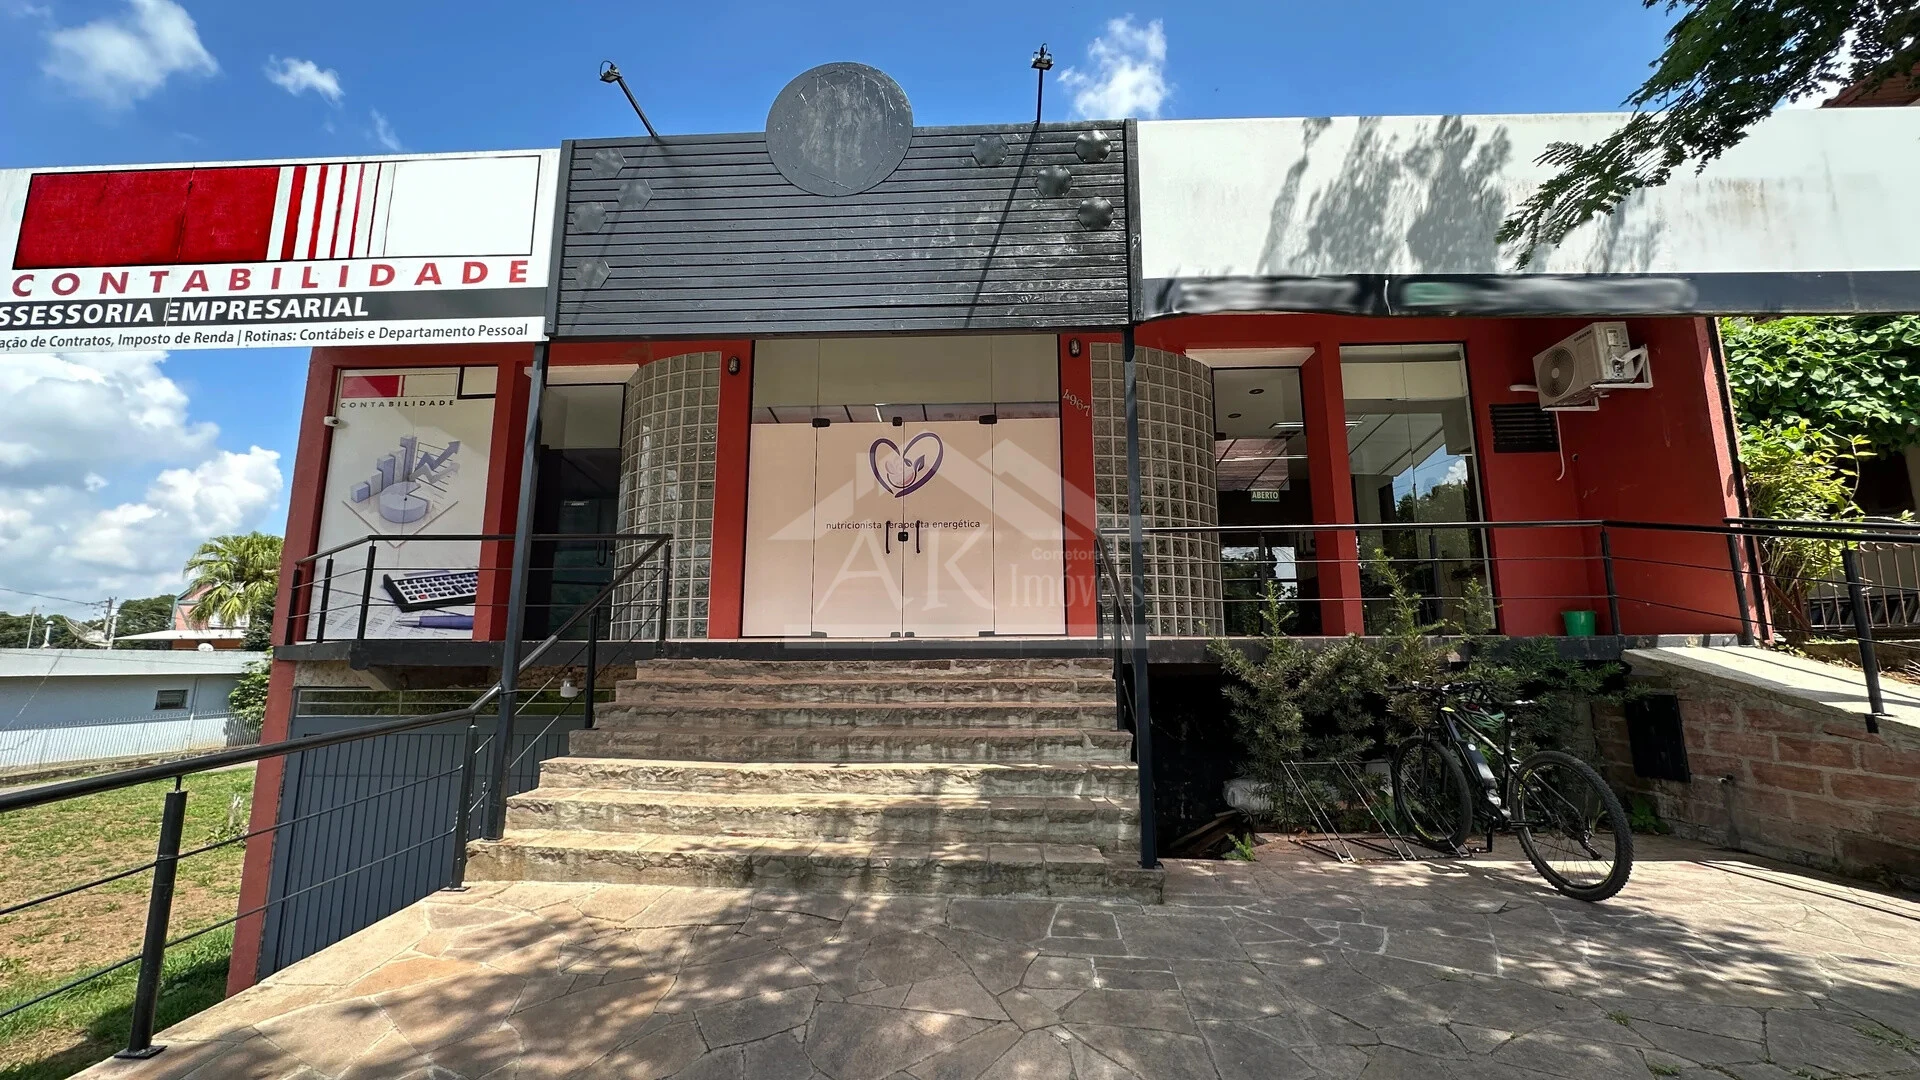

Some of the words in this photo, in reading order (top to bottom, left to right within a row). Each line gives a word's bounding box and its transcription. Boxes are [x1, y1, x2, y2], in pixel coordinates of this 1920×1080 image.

[12, 260, 530, 297] CONTABILIDADE
[165, 297, 369, 323] EMPRESARIAL
[30, 335, 46, 349] de
[49, 335, 115, 348] Contratos,
[118, 332, 171, 348] Imposto
[172, 332, 191, 344] de
[193, 331, 235, 344] Renda
[244, 329, 297, 343] Rotinas:
[299, 326, 365, 341] Contábeis
[367, 329, 376, 339] e
[379, 325, 475, 341] Departamento
[478, 324, 528, 337] Pessoal
[340, 400, 455, 409] CONTABILIDADE
[1062, 388, 1091, 417] 4967
[1252, 491, 1279, 499] ABERTO
[826, 520, 882, 530] nutricionista
[932, 518, 981, 531] energética
